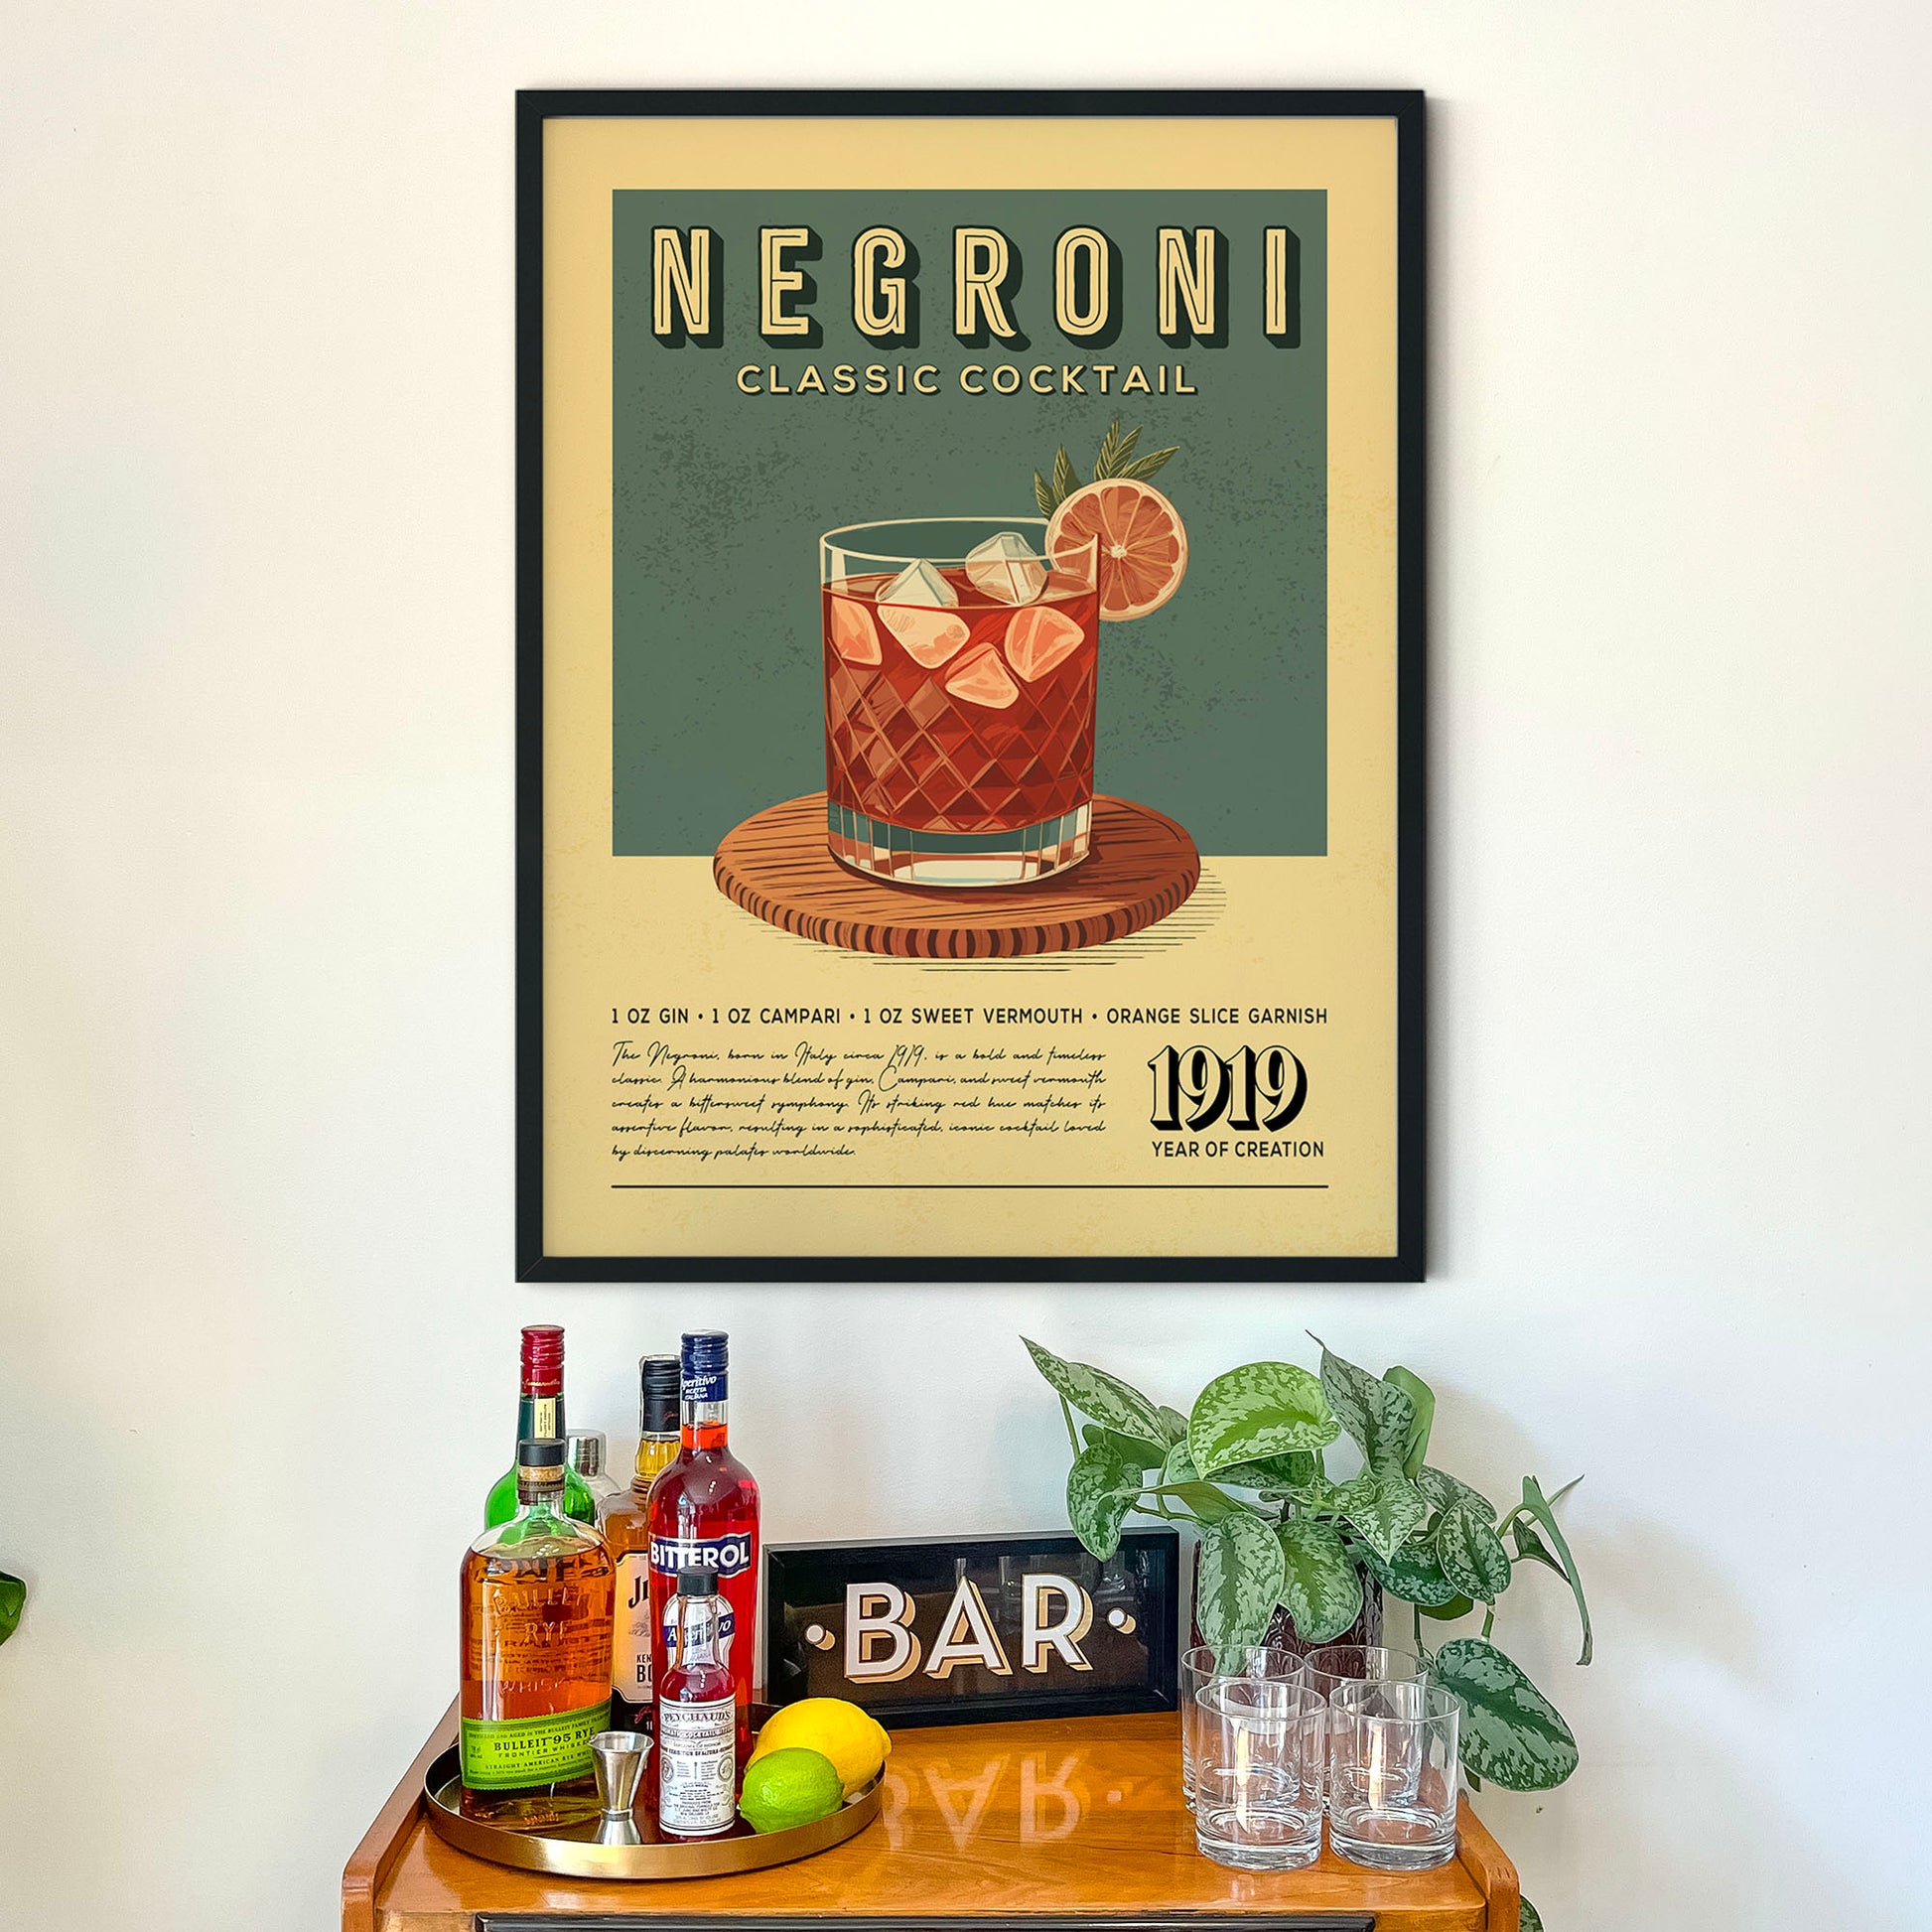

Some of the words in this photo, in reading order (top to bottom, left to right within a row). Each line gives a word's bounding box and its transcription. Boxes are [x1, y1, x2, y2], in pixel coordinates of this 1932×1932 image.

[650, 224, 1302, 351] NEGRONI
[736, 363, 941, 397] CLASSIC
[959, 363, 1198, 397] COCKTAIL
[613, 1009, 618, 1024] 1
[627, 1009, 649, 1024] OZ
[659, 1008, 688, 1024] GIN
[713, 1009, 719, 1024] 1
[729, 1009, 751, 1024] OZ
[760, 1009, 839, 1024] CAMPARI
[865, 1009, 871, 1024] 1
[880, 1009, 901, 1024] OZ
[912, 1008, 973, 1024] SWEET
[984, 1008, 1081, 1024] VERMOUTH
[1107, 1008, 1179, 1024] ORANGE
[1190, 1008, 1239, 1024] SLICE
[1249, 1008, 1326, 1024] GARNISH
[613, 1040, 640, 1066] The
[728, 1049, 764, 1059] born
[771, 1049, 788, 1060] in
[795, 1041, 836, 1067] Italy
[844, 1049, 884, 1060] circa
[935, 1049, 948, 1061] is
[973, 1048, 1006, 1060] bold
[1013, 1048, 1042, 1059] and
[1046, 1046, 1106, 1064] timeless
[667, 1065, 686, 1091] A
[689, 1072, 780, 1084] harmonious
[783, 1072, 825, 1084] blend
[828, 1069, 844, 1089] of
[960, 1072, 990, 1083] and
[992, 1070, 1032, 1089] sweet
[1034, 1070, 1106, 1088] vermouth
[1148, 1044, 1308, 1132] 1919
[612, 1094, 663, 1113] creates
[689, 1094, 765, 1113] bittersweet
[858, 1089, 880, 1115] Its
[887, 1094, 945, 1113] striking
[953, 1097, 980, 1107] red
[988, 1097, 1017, 1107] hue
[1024, 1094, 1081, 1113] matches
[1090, 1094, 1106, 1113] its
[612, 1118, 677, 1137] assertive
[739, 1118, 807, 1138] resulting
[812, 1121, 829, 1132] in
[949, 1121, 995, 1132] iconic
[1000, 1118, 1059, 1137] cocktail
[1064, 1121, 1106, 1132] loved
[612, 1145, 630, 1162] by
[633, 1145, 712, 1162] discerning
[714, 1143, 768, 1161] palates
[1152, 1142, 1199, 1157] YEAR
[1205, 1141, 1228, 1157] OF
[1235, 1141, 1323, 1157] CREATION
[682, 1374, 717, 1390] peritivo
[650, 1542, 750, 1569] BITTEROL
[844, 1573, 1093, 1684] BAR
[493, 1737, 547, 1752] BULLEIT
[552, 1731, 572, 1745] 95
[575, 1725, 595, 1739] RYE
[497, 1746, 548, 1758] FRONTIER
[552, 1738, 591, 1751] WHISKE
[523, 1756, 559, 1767] AMERICAN
